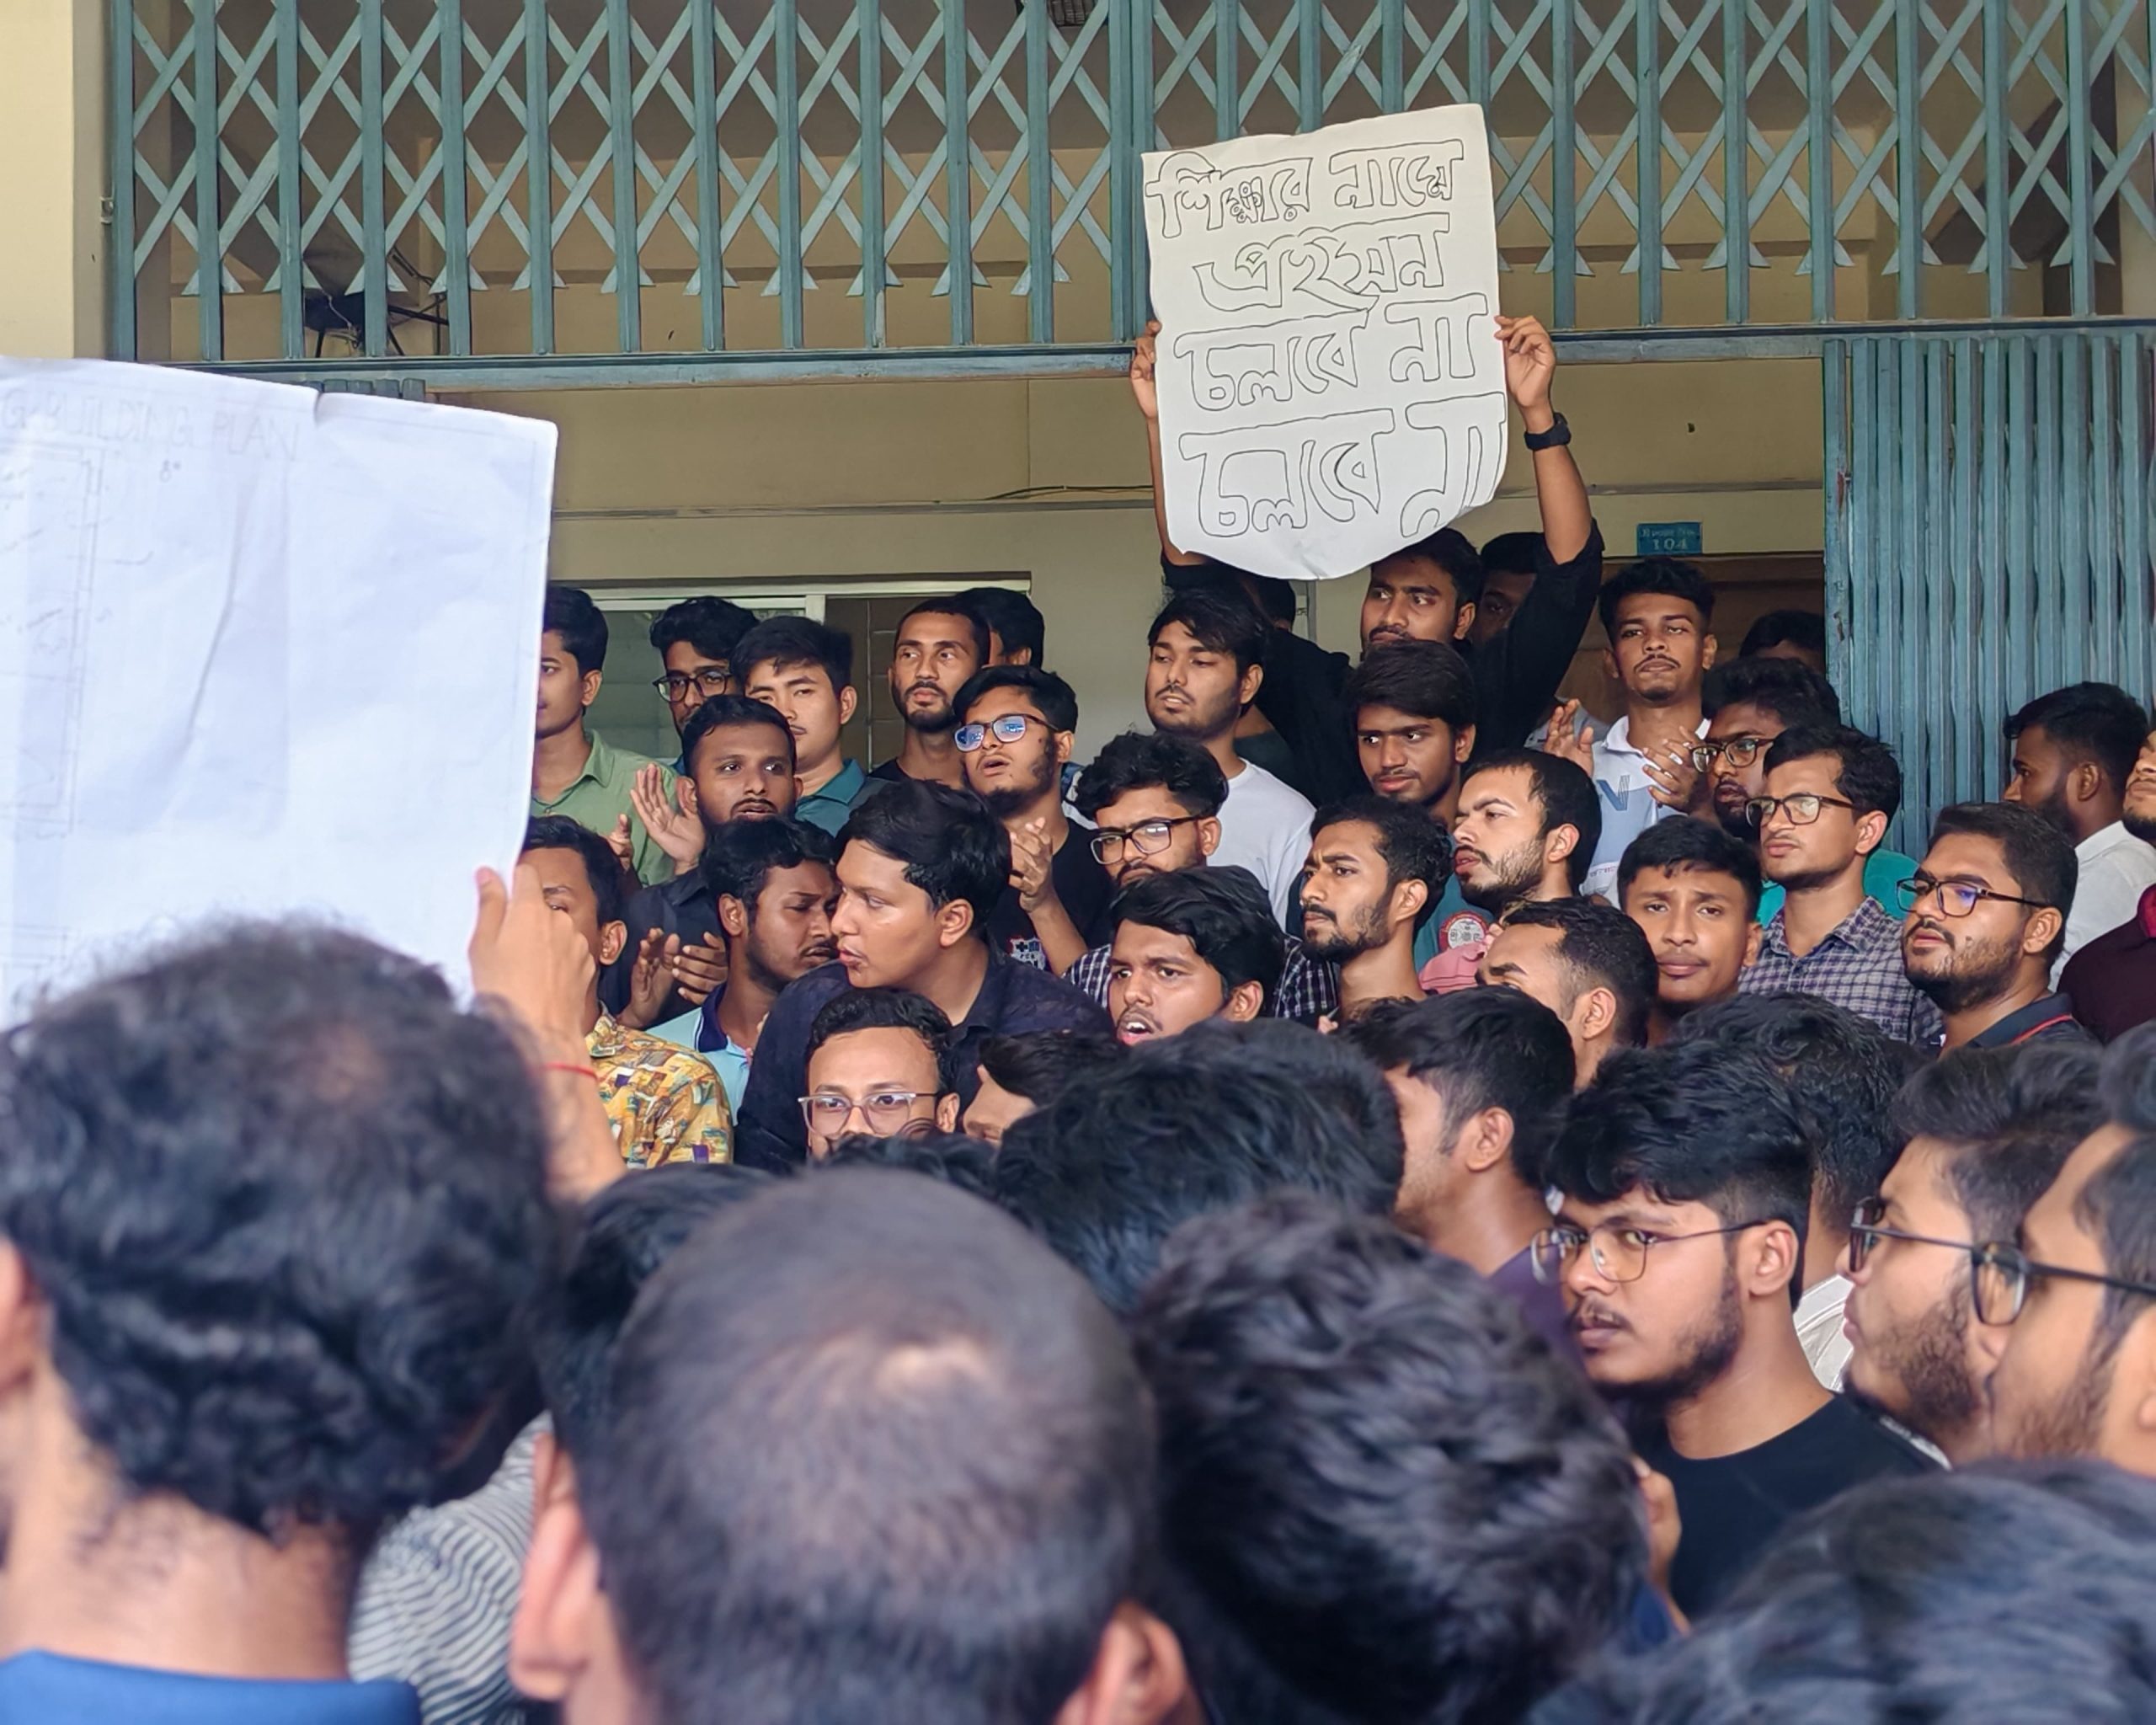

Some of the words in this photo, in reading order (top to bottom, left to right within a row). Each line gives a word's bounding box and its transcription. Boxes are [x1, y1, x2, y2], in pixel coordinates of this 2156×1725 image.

[1329, 140, 1464, 208] নামে
[1174, 308, 1370, 411] চলবে
[1385, 292, 1488, 382] না
[1179, 408, 1396, 537] চলবে
[1400, 392, 1506, 537] না
